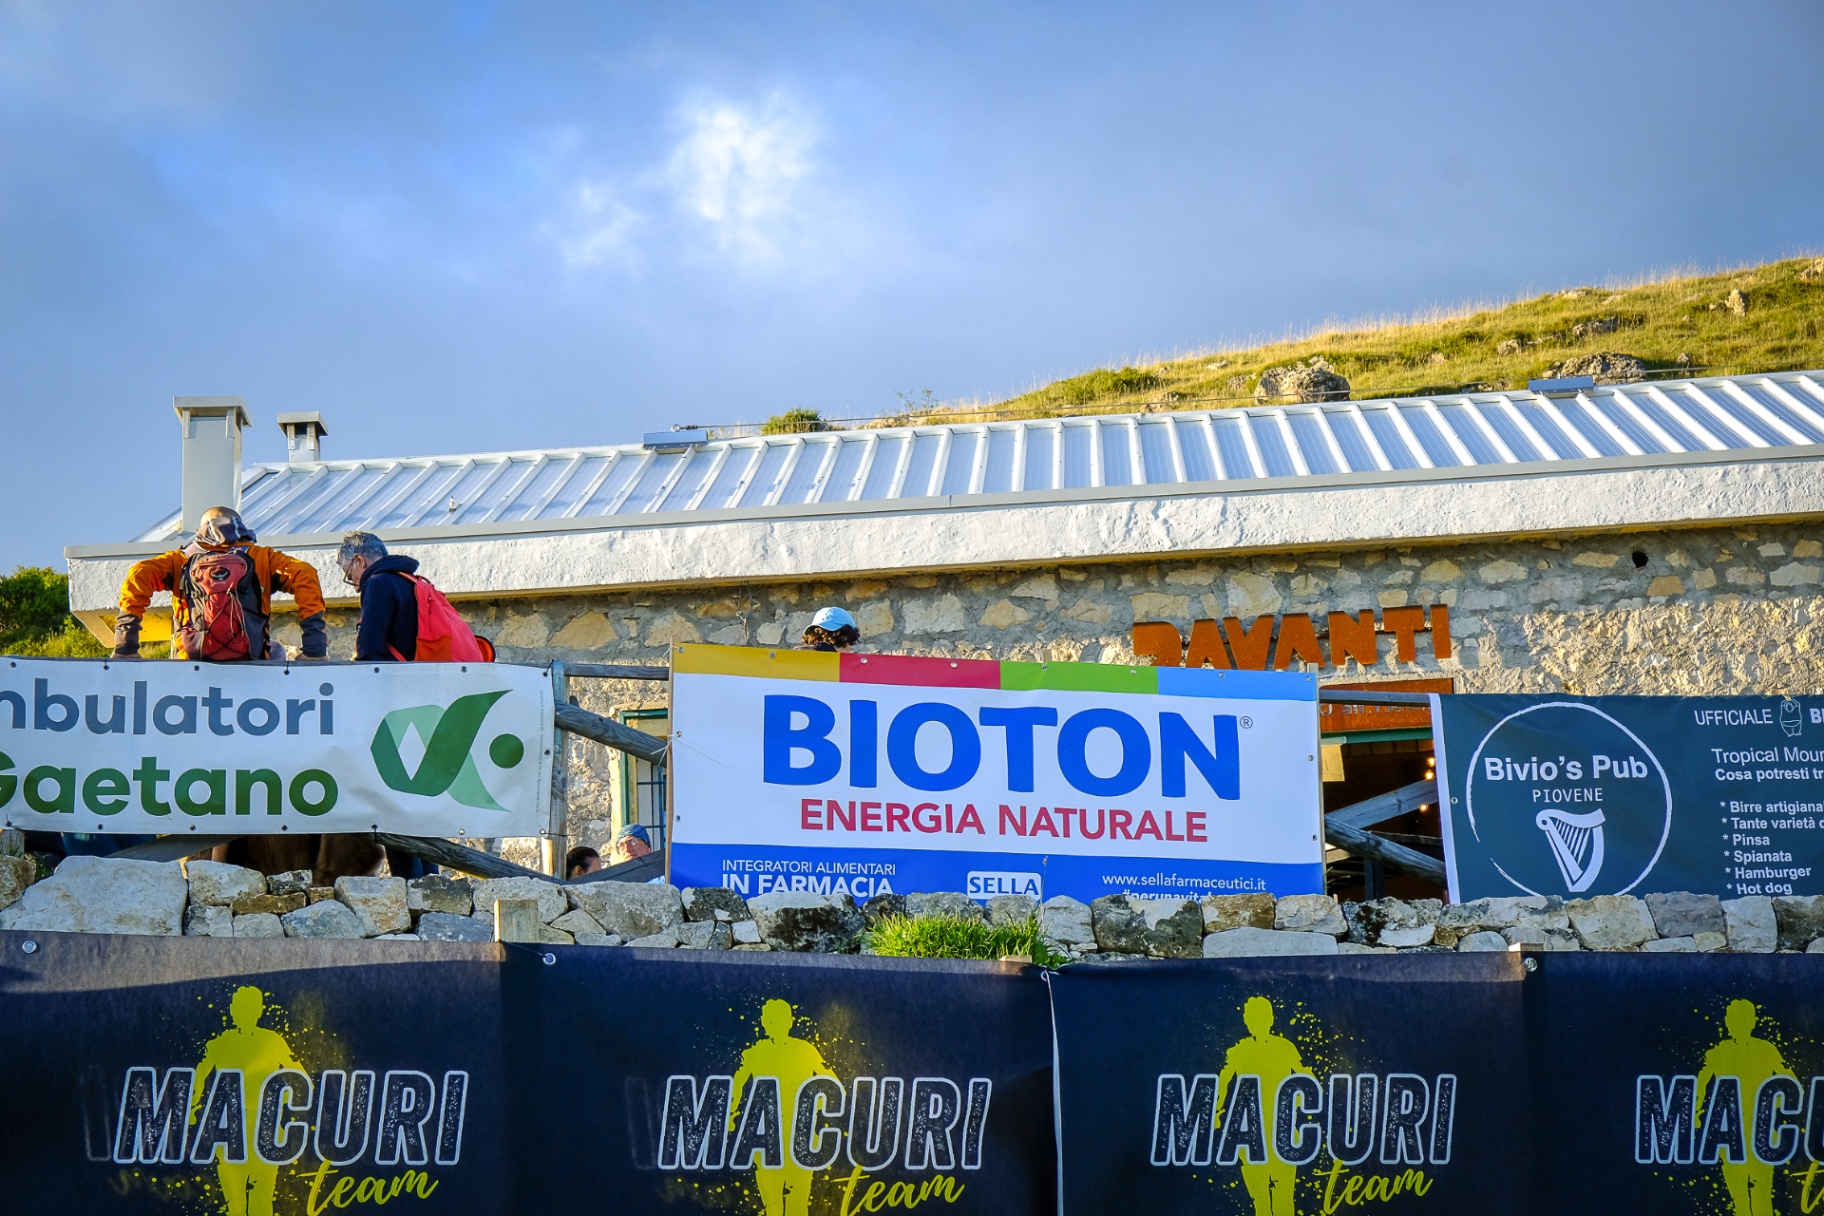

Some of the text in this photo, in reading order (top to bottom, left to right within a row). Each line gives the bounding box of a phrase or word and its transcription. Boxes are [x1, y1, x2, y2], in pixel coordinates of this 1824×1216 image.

[1694, 708, 1774, 726] UFFICIALE
[1711, 747, 1780, 767] Tropical
[1592, 755, 1648, 779] Pub
[1715, 768, 1752, 781] Cosa
[1756, 767, 1810, 783] potresti
[1532, 788, 1603, 803] PIOVENE
[1729, 801, 1763, 813] Birre
[801, 799, 1208, 843] ENERGIA NATURALE
[1731, 817, 1768, 829] Tante
[1770, 816, 1816, 829] varietà
[1732, 833, 1771, 846] Pinsa
[1733, 850, 1793, 865] Spianata
[722, 860, 896, 876] INTEGRATORI ALIMENTARI
[1735, 867, 1812, 880] Hamburger
[722, 873, 893, 898] IN FARMACIA
[969, 876, 1039, 896] SELLA
[1102, 873, 1267, 892] www.sellafarmaceutici.it
[1736, 882, 1793, 896] Hot dog
[113, 1066, 470, 1167] MACURI
[656, 1075, 993, 1171] MACURI
[1150, 1074, 1457, 1167] MACURI
[297, 1158, 440, 1216] team
[831, 1164, 966, 1216] team
[1314, 1159, 1434, 1215] team
